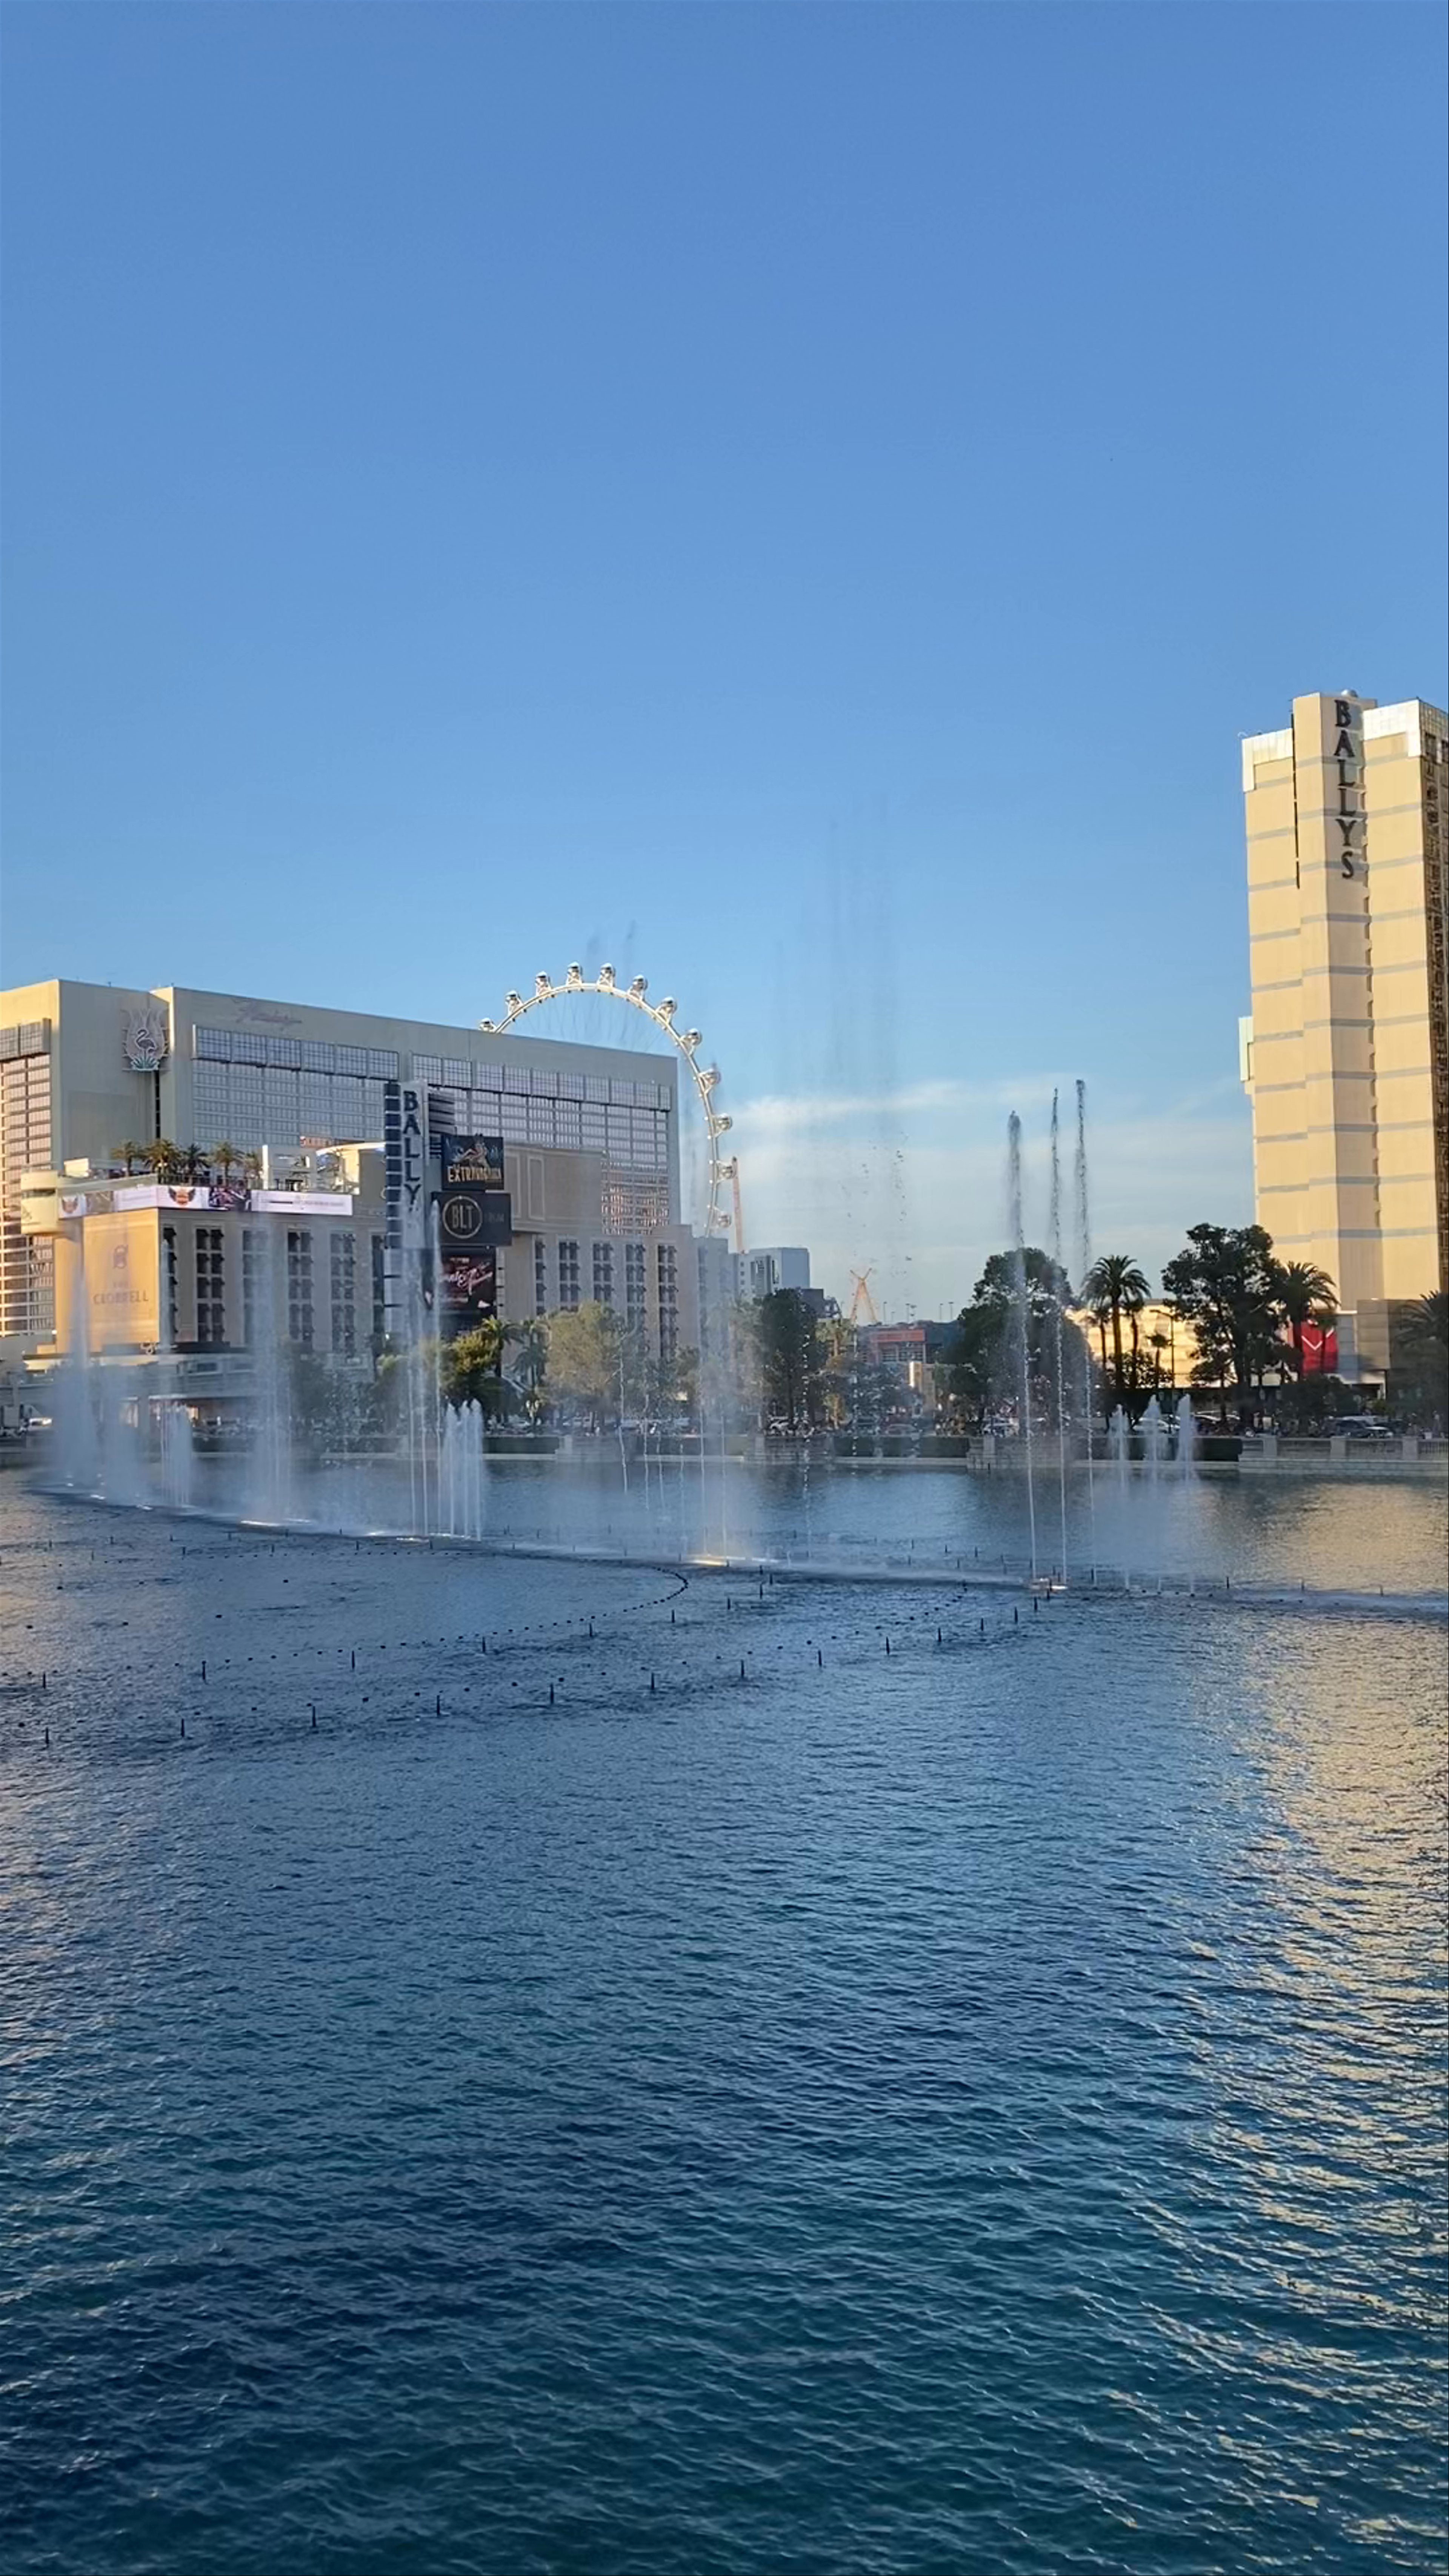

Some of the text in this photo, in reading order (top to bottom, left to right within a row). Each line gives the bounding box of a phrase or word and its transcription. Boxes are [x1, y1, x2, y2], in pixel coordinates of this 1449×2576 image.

[1334, 699, 1356, 879] BALLYS
[403, 1090, 421, 1212] BALLY
[447, 1164, 502, 1183] EXTRAVA
[452, 1204, 474, 1229] BLT
